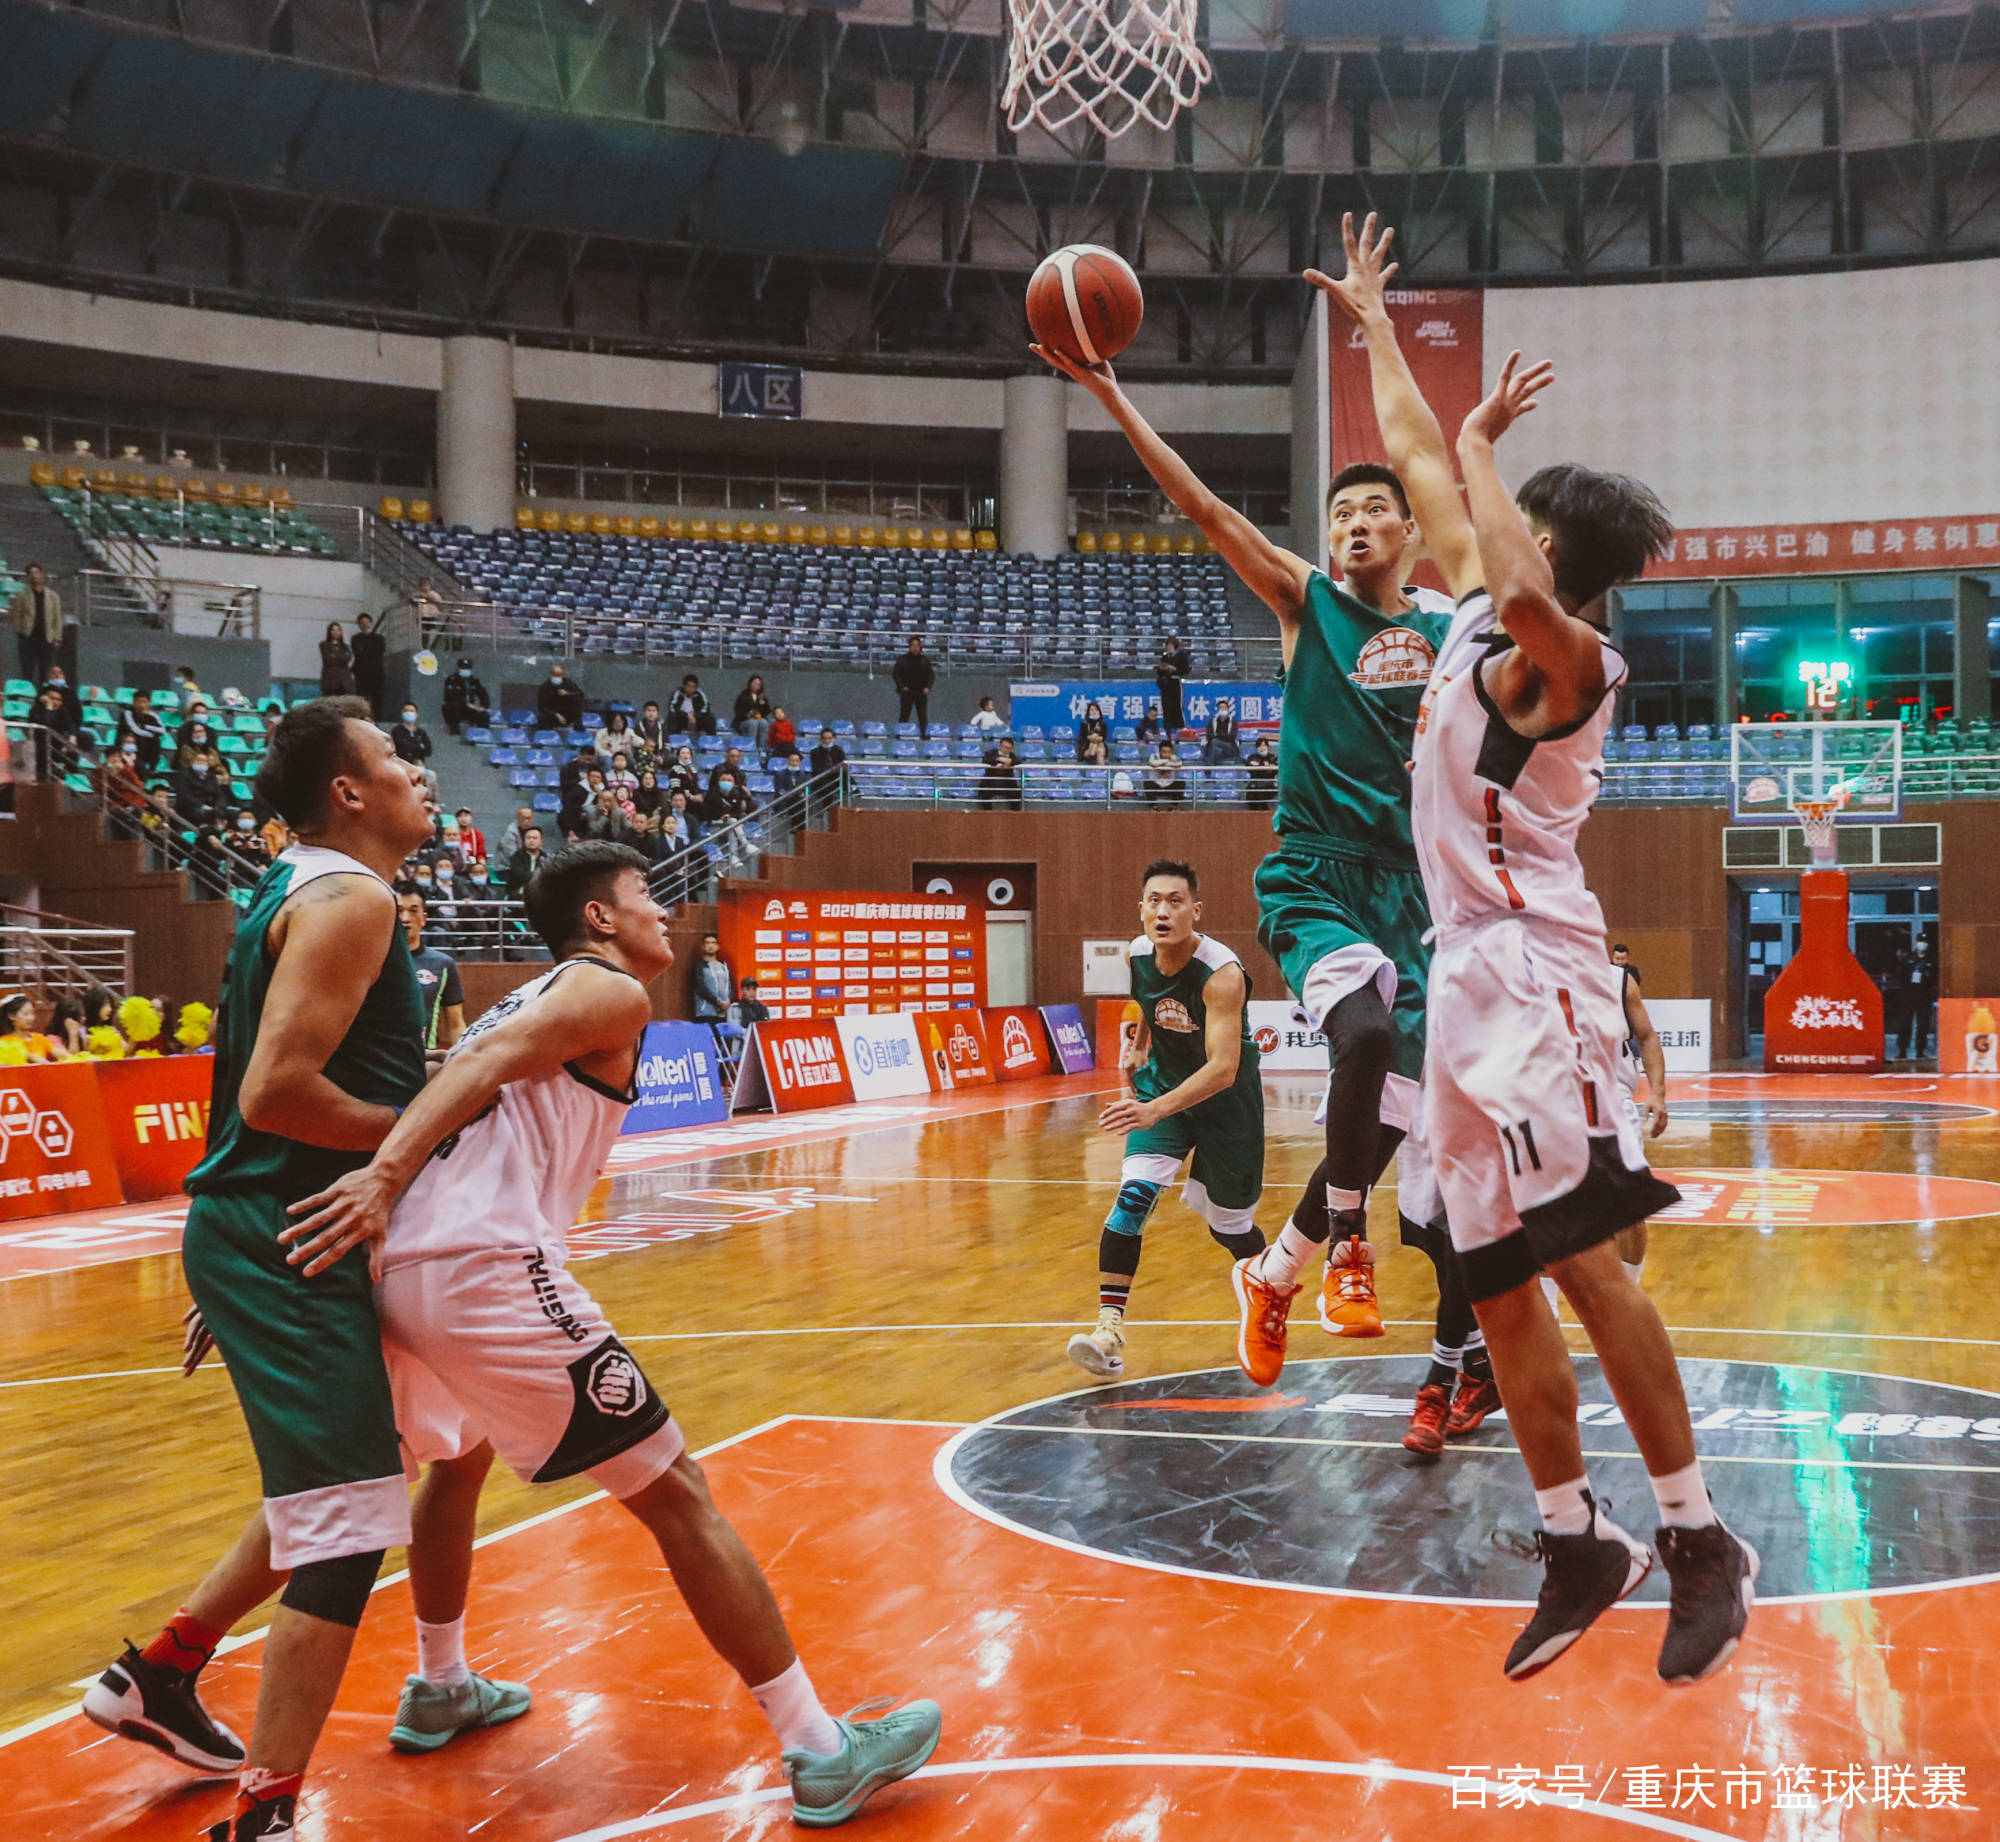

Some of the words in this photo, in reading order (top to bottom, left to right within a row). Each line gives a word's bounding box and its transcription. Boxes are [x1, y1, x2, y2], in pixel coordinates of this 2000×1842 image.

[729, 371, 794, 410] 八区
[1807, 680, 1838, 708] 12
[795, 1036, 836, 1064] PARK
[873, 1038, 914, 1069] 直播吧
[1974, 1034, 1989, 1053] G
[1502, 1118, 1542, 1176] 11
